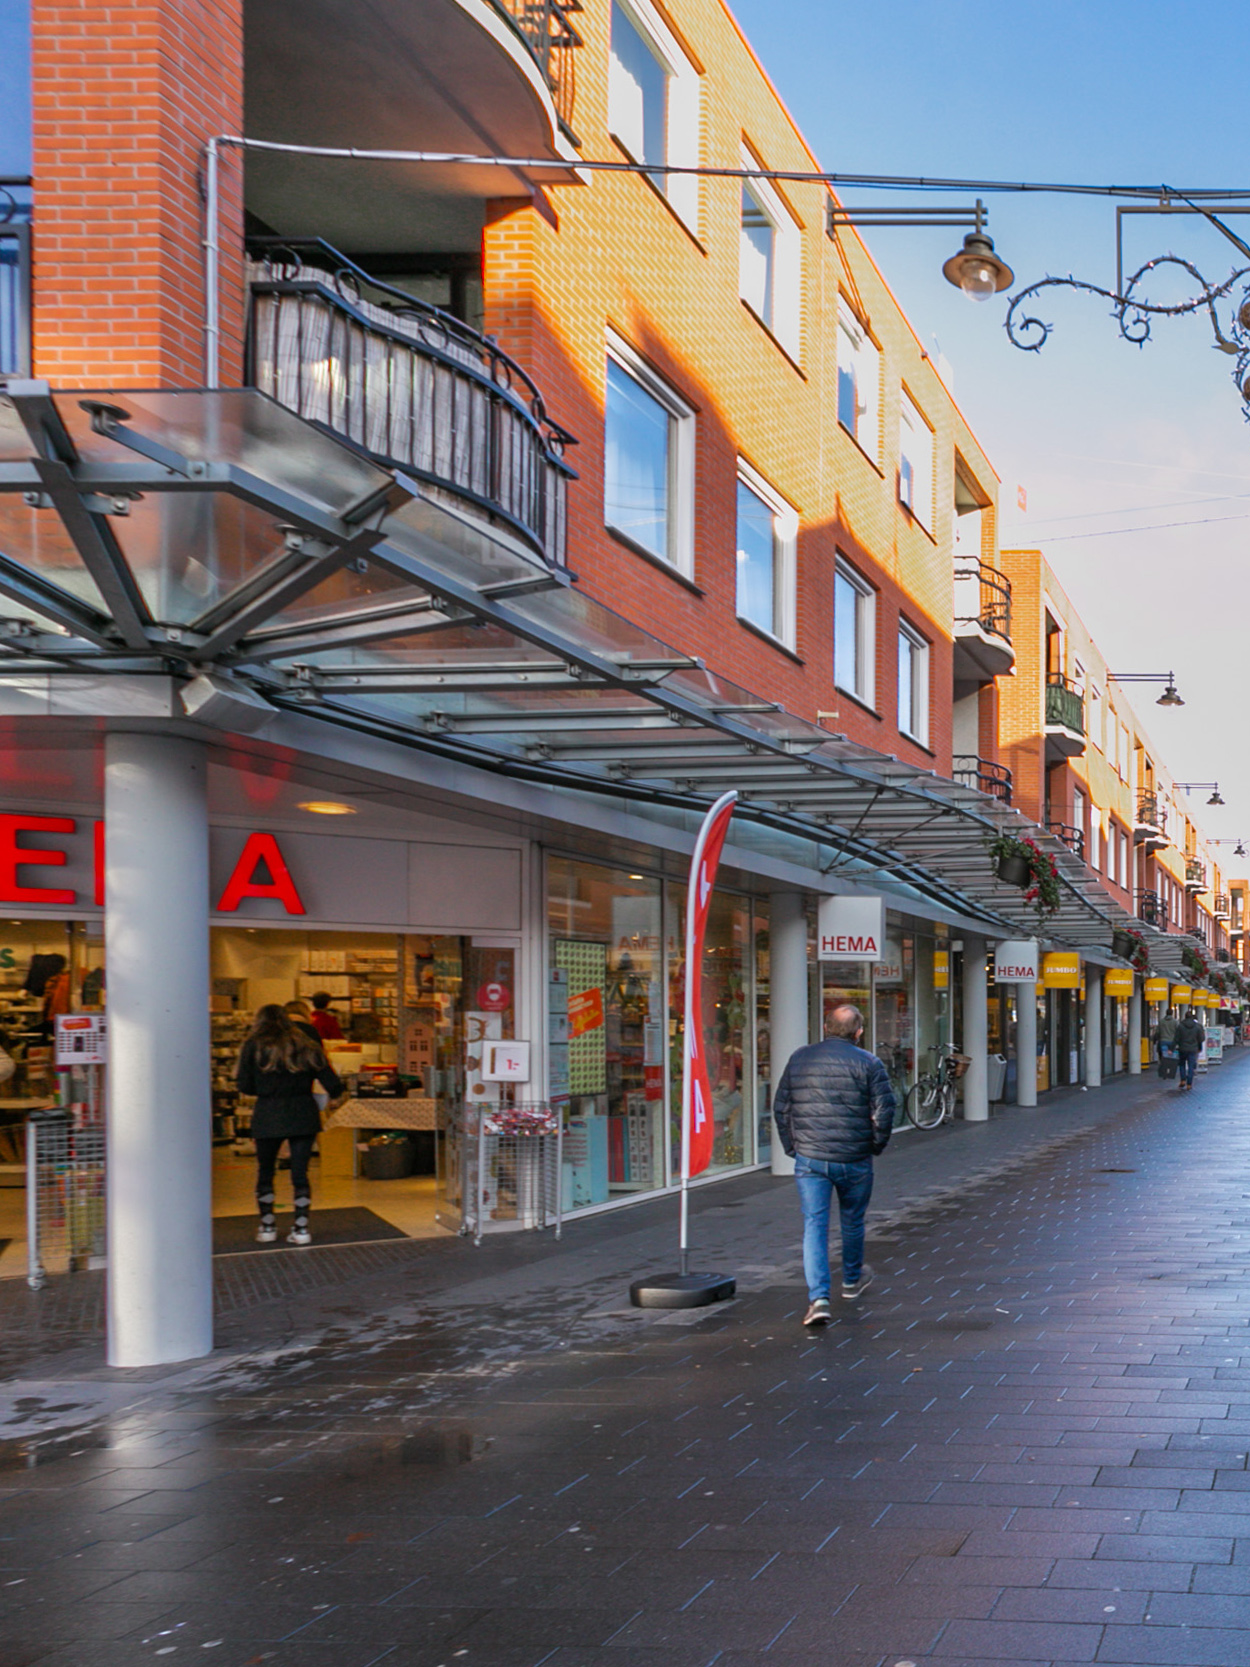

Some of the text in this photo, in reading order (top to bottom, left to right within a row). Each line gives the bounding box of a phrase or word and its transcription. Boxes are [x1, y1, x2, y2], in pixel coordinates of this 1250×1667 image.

[0, 813, 307, 915] EA
[822, 936, 877, 952] HEMA
[997, 966, 1035, 977] HEMA
